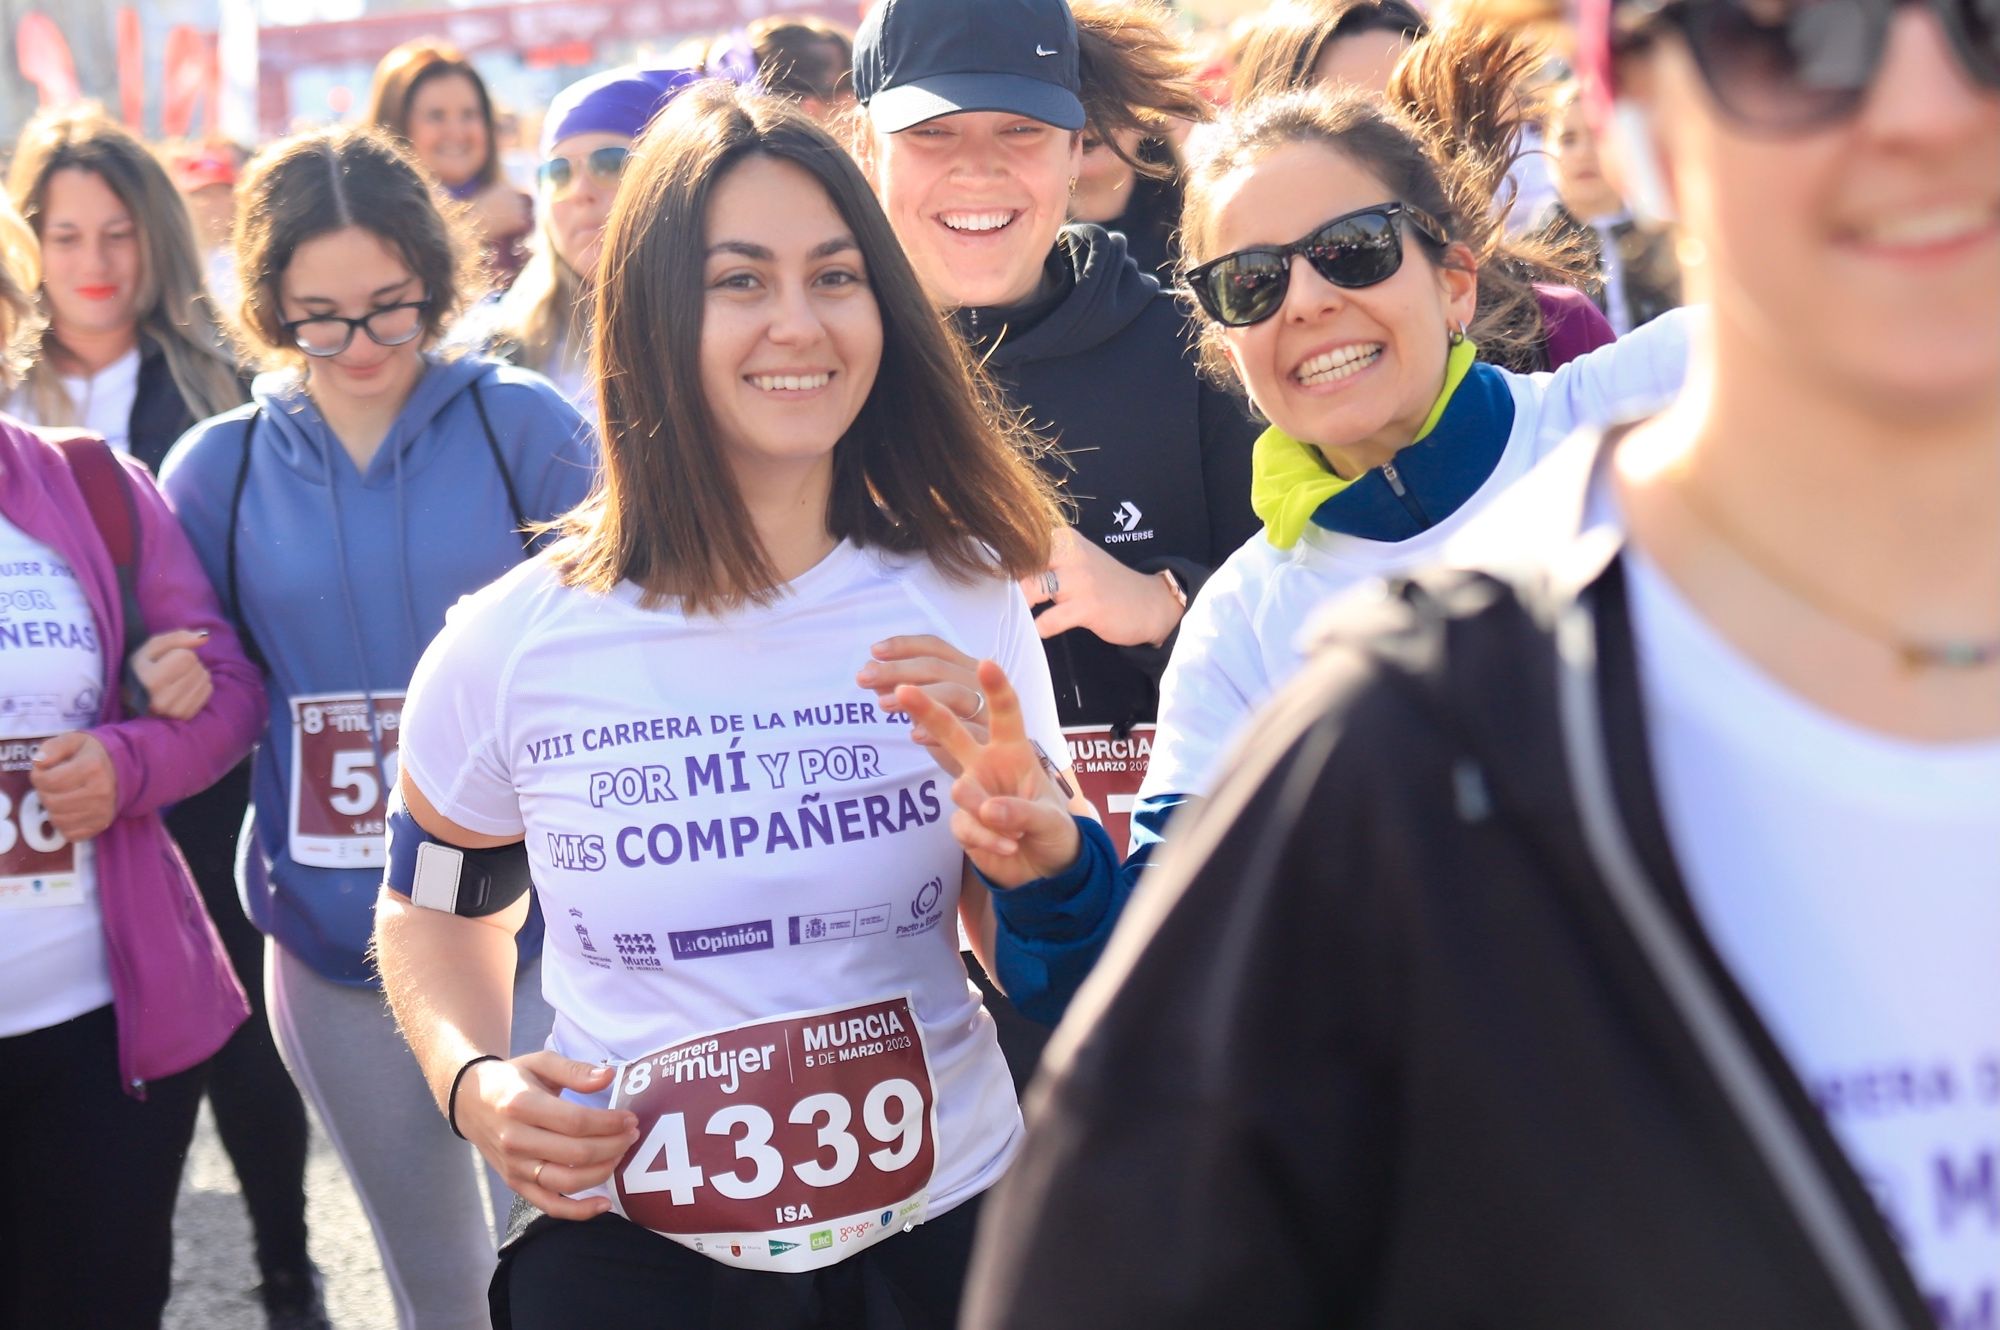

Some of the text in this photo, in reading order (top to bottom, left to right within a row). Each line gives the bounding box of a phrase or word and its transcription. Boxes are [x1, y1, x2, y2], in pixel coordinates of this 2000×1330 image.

[1105, 530, 1154, 544] CONVERSE
[0, 562, 42, 577] UJER
[0, 617, 97, 653] ÑERAS
[527, 733, 575, 764] VIII
[582, 715, 702, 750] CARRERA
[710, 714, 745, 734] DE
[753, 712, 785, 730] LA
[794, 701, 877, 726] MUJER
[590, 736, 887, 808] POR MÍ Y POR
[1086, 761, 1127, 773] MARZO
[1129, 760, 1149, 771] 202
[547, 780, 942, 871] MIS COMPAÑERAS
[621, 955, 661, 967] Murcia
[803, 1010, 904, 1052] MURCIA
[659, 1039, 719, 1066] carrera
[675, 1044, 775, 1094] mujer
[805, 1036, 912, 1068] 5 DE MARZO 2023
[622, 1078, 925, 1206] 4339
[776, 1203, 814, 1224] ISA
